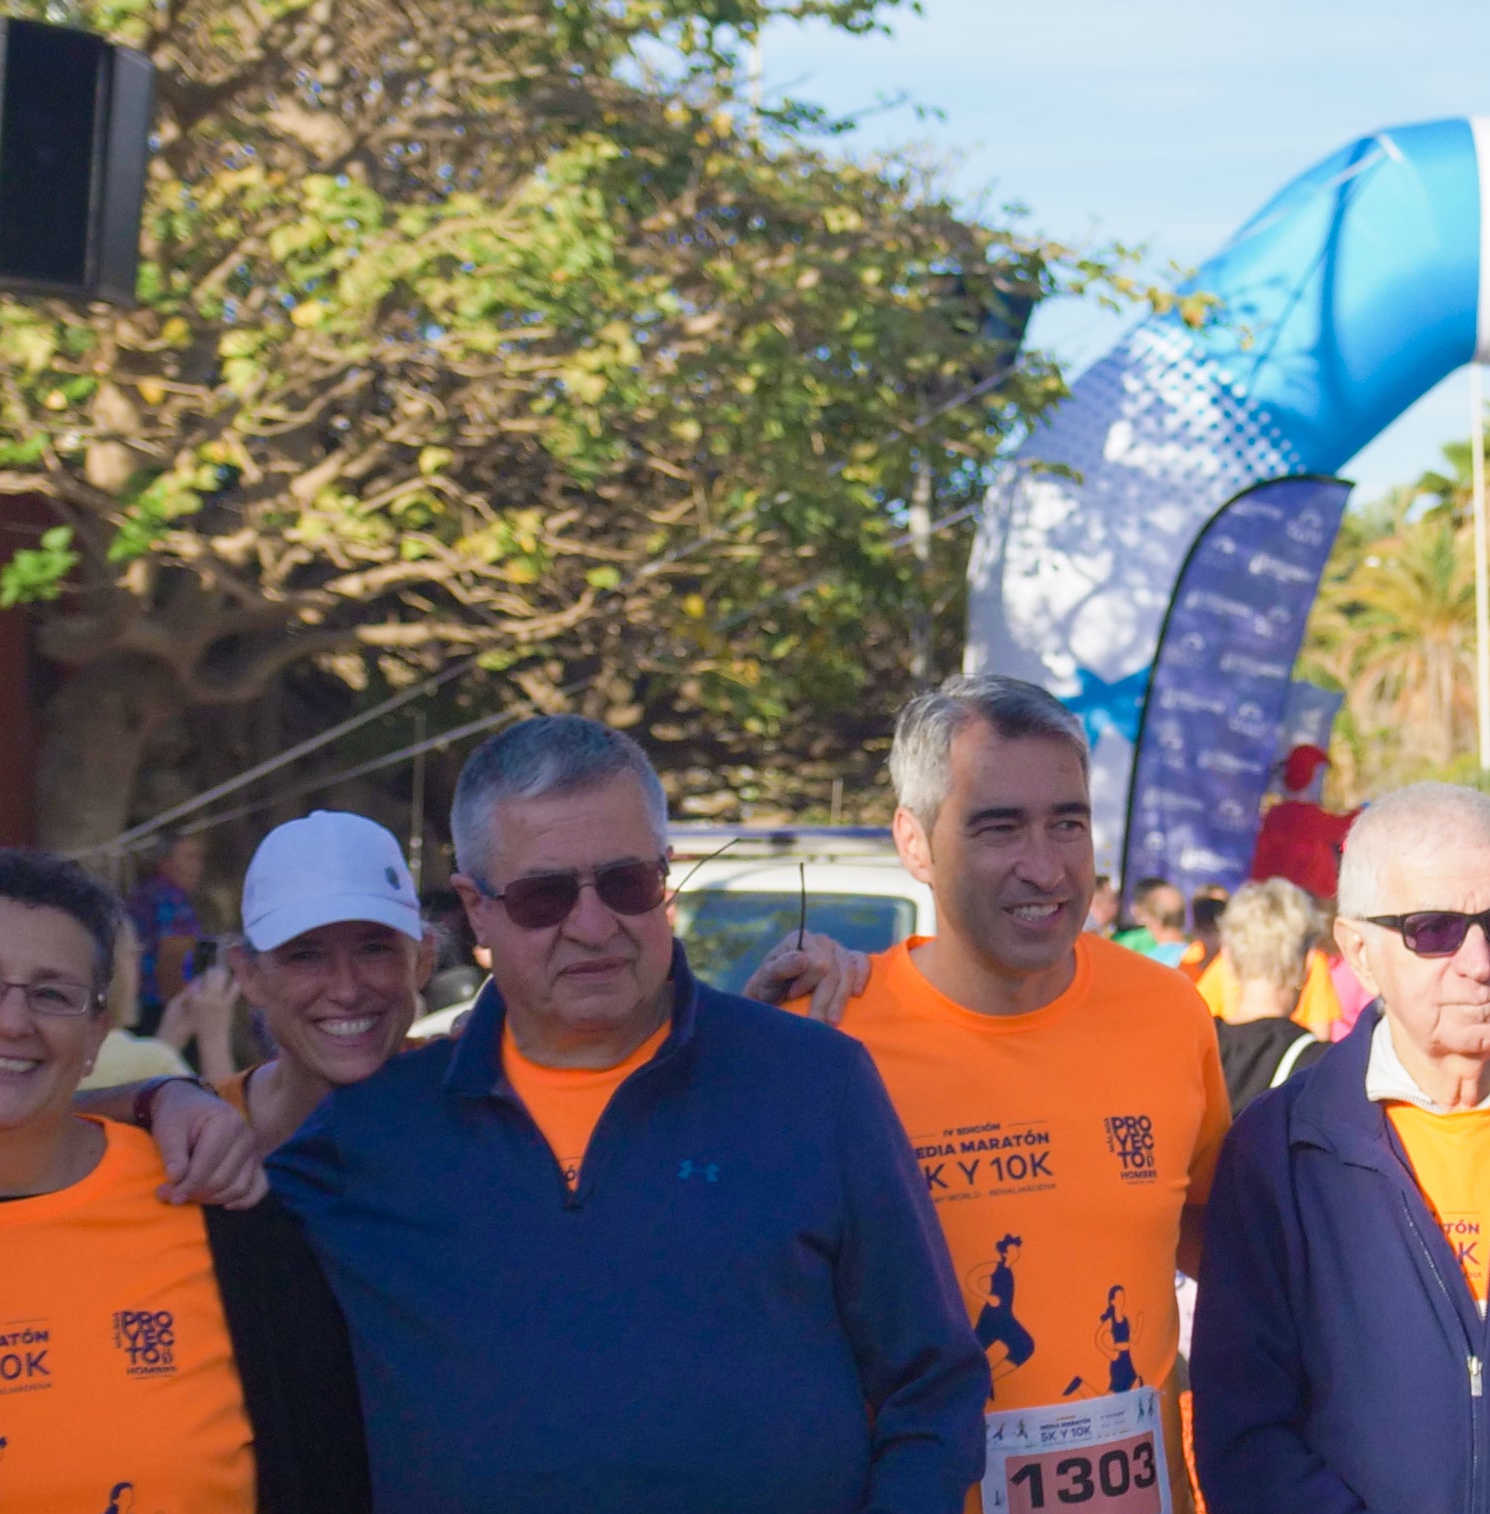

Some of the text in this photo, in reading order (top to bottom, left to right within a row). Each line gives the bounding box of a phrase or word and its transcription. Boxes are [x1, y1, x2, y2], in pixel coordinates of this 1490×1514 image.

[1111, 1115, 1152, 1134] PRO
[915, 1129, 1049, 1160] EDIA MARATÓN
[1114, 1131, 1154, 1150] YEC
[924, 1151, 1053, 1190] K Y 10K
[122, 1311, 173, 1330] PRO
[123, 1328, 174, 1347] YEC
[1041, 1425, 1092, 1442] 5K Y 10K
[1010, 1442, 1156, 1509] 1303
